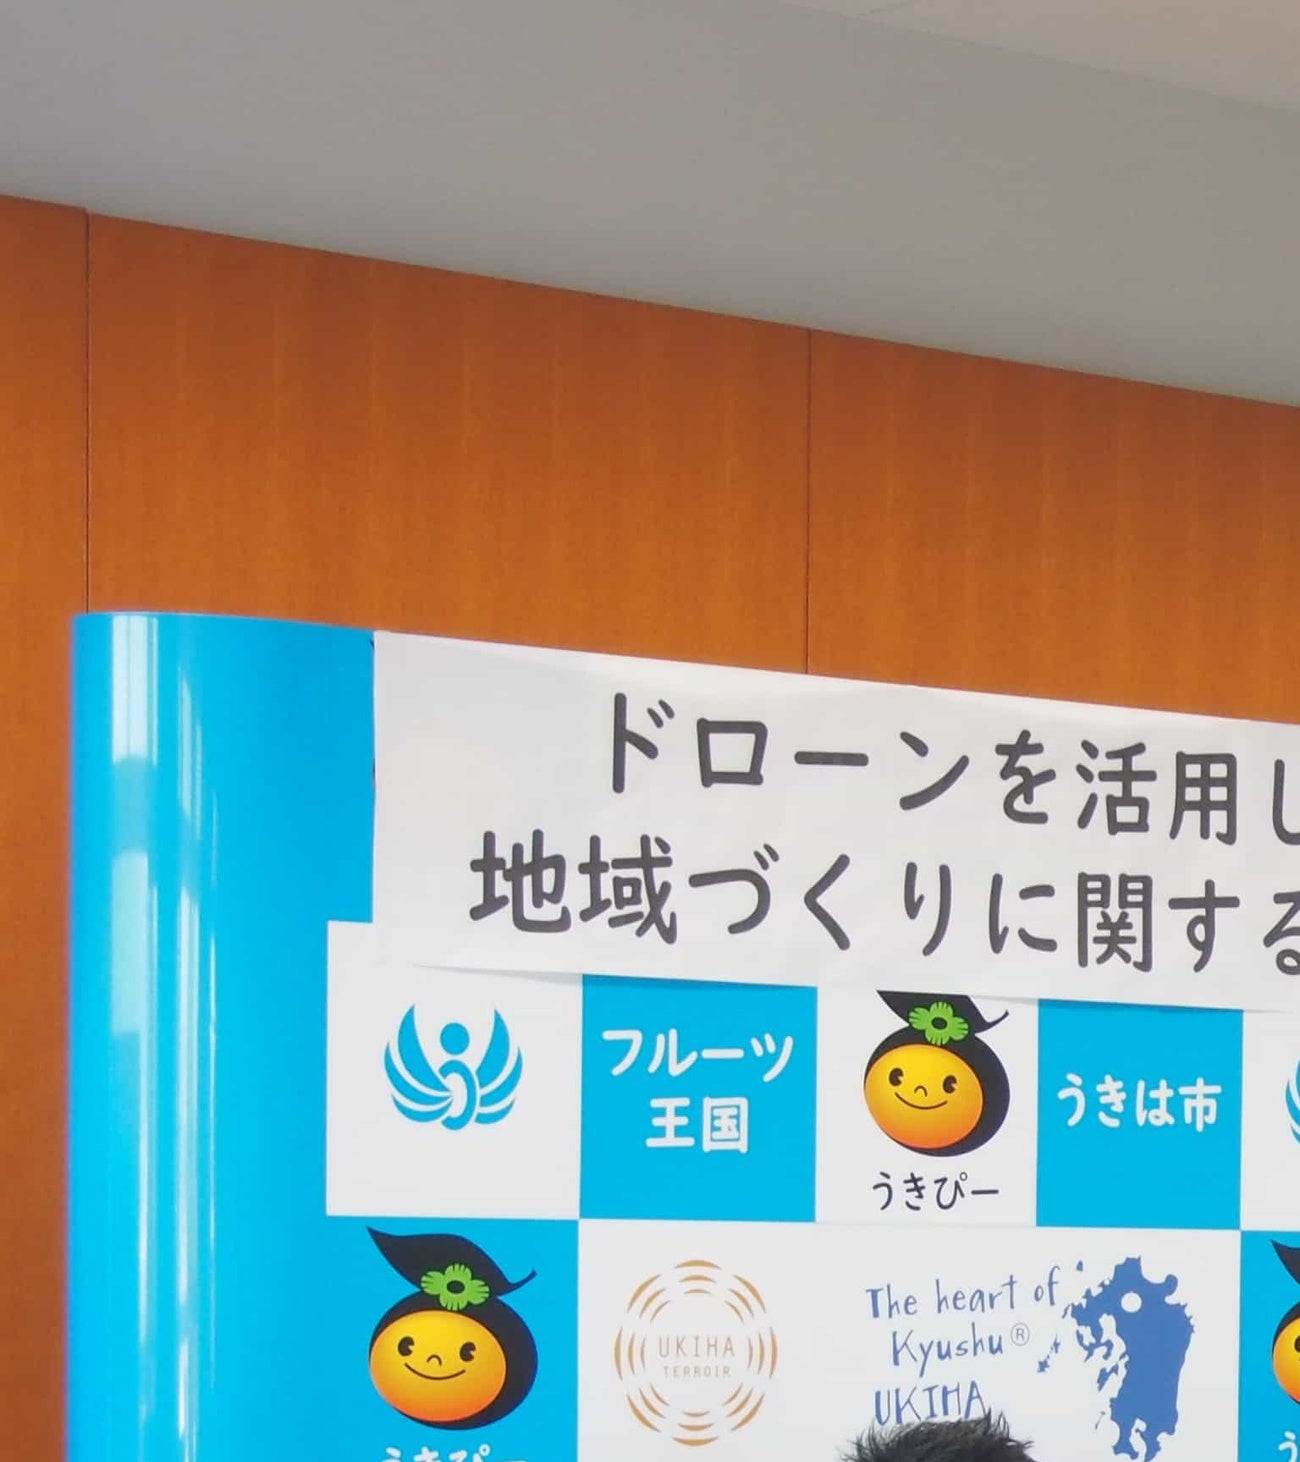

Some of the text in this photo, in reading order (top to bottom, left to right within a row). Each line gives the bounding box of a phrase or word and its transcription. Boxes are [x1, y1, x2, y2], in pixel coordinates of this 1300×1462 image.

[603, 1029, 793, 1081] フルーツ
[647, 1097, 748, 1152] 王国
[1059, 1074, 1221, 1131] うきは市
[873, 1172, 998, 1210] うきぴー
[865, 1265, 1061, 1319] The heart of
[657, 1335, 736, 1358] UKIHA
[663, 1365, 732, 1379] TERROIR
[875, 1381, 987, 1426] UKIHA
